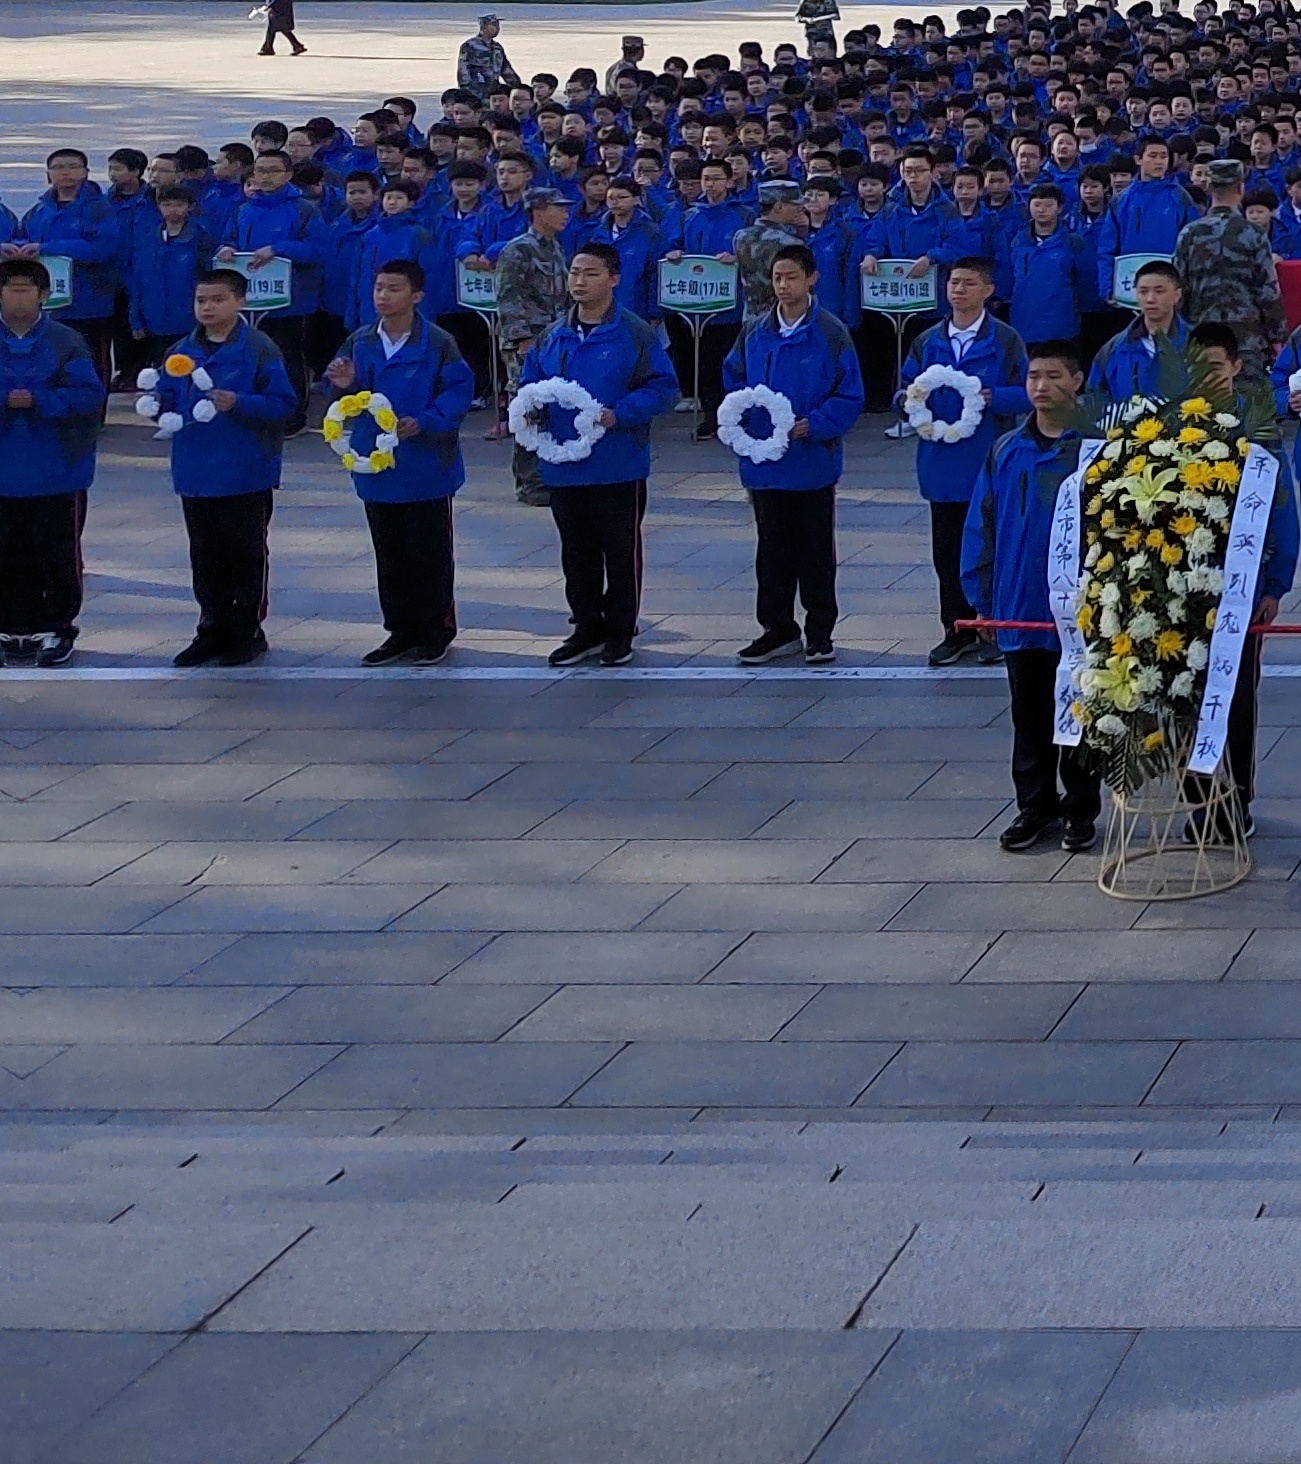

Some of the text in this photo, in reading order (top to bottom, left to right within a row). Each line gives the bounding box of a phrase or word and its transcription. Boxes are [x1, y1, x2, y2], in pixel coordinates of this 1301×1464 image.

[665, 278, 730, 297] 七年级(17)班
[868, 281, 930, 298] 七年级(16)班
